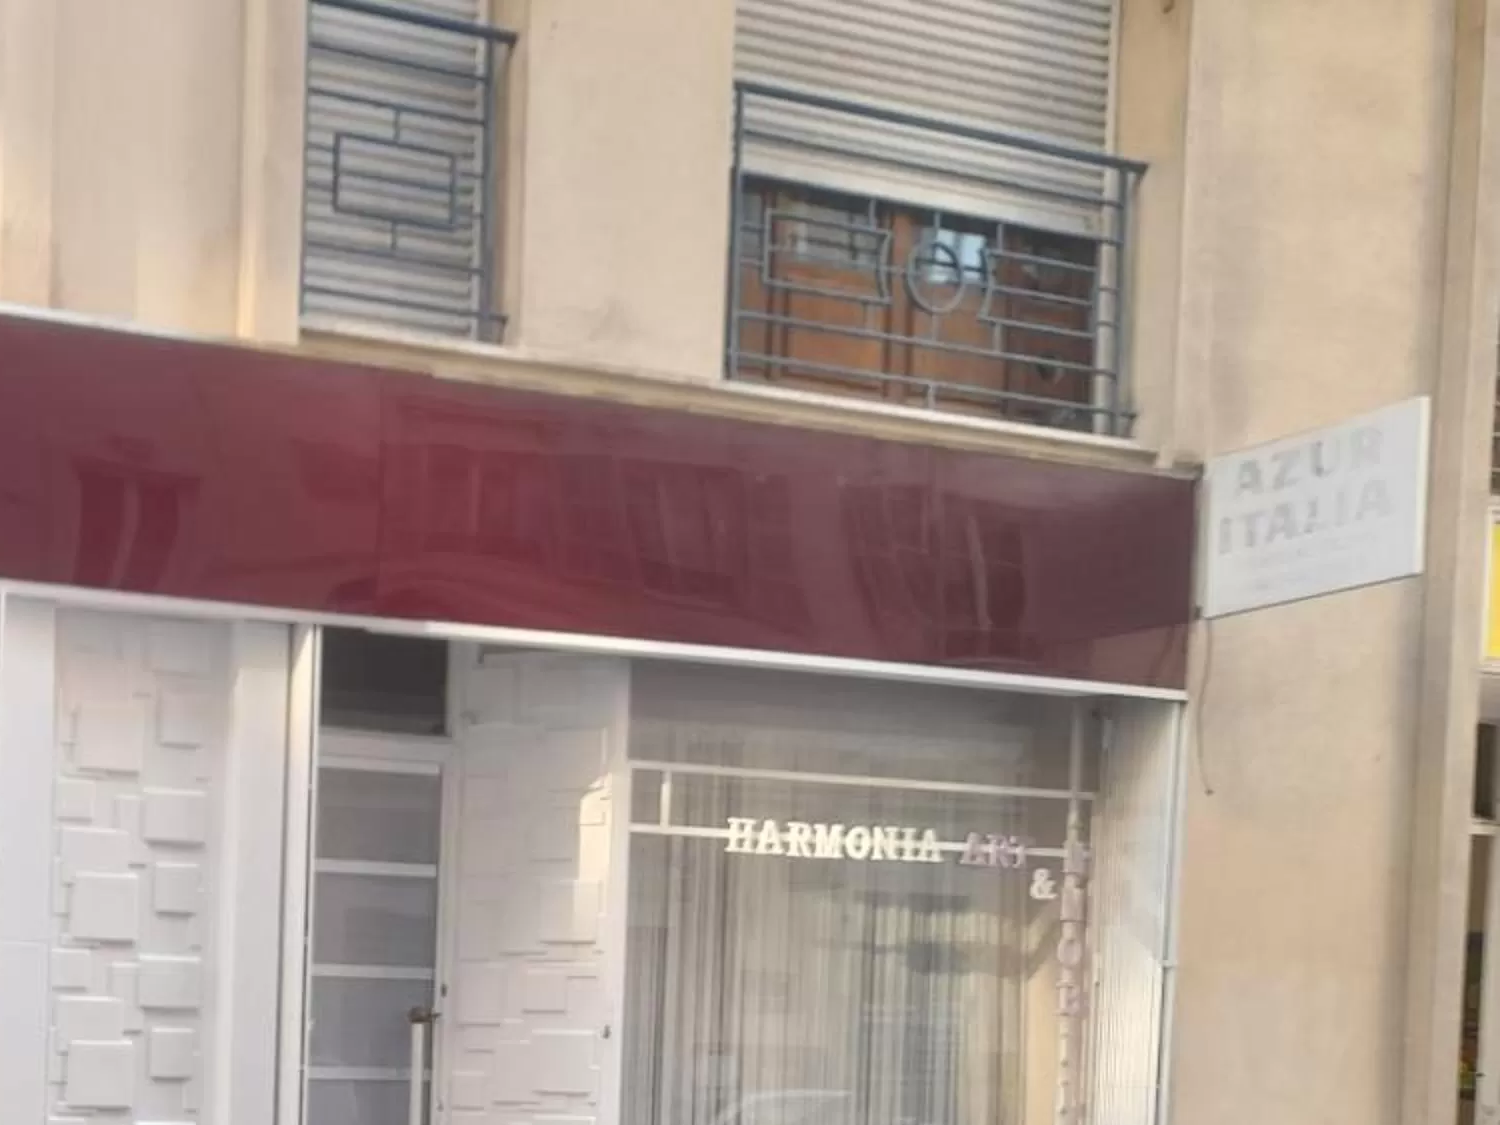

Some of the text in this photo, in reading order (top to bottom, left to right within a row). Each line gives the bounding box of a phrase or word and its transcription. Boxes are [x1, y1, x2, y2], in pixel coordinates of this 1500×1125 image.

[1235, 427, 1384, 498] AZUR
[1217, 477, 1396, 555] ITALIA
[725, 816, 943, 863] HARMONIA
[1029, 867, 1059, 900] &
